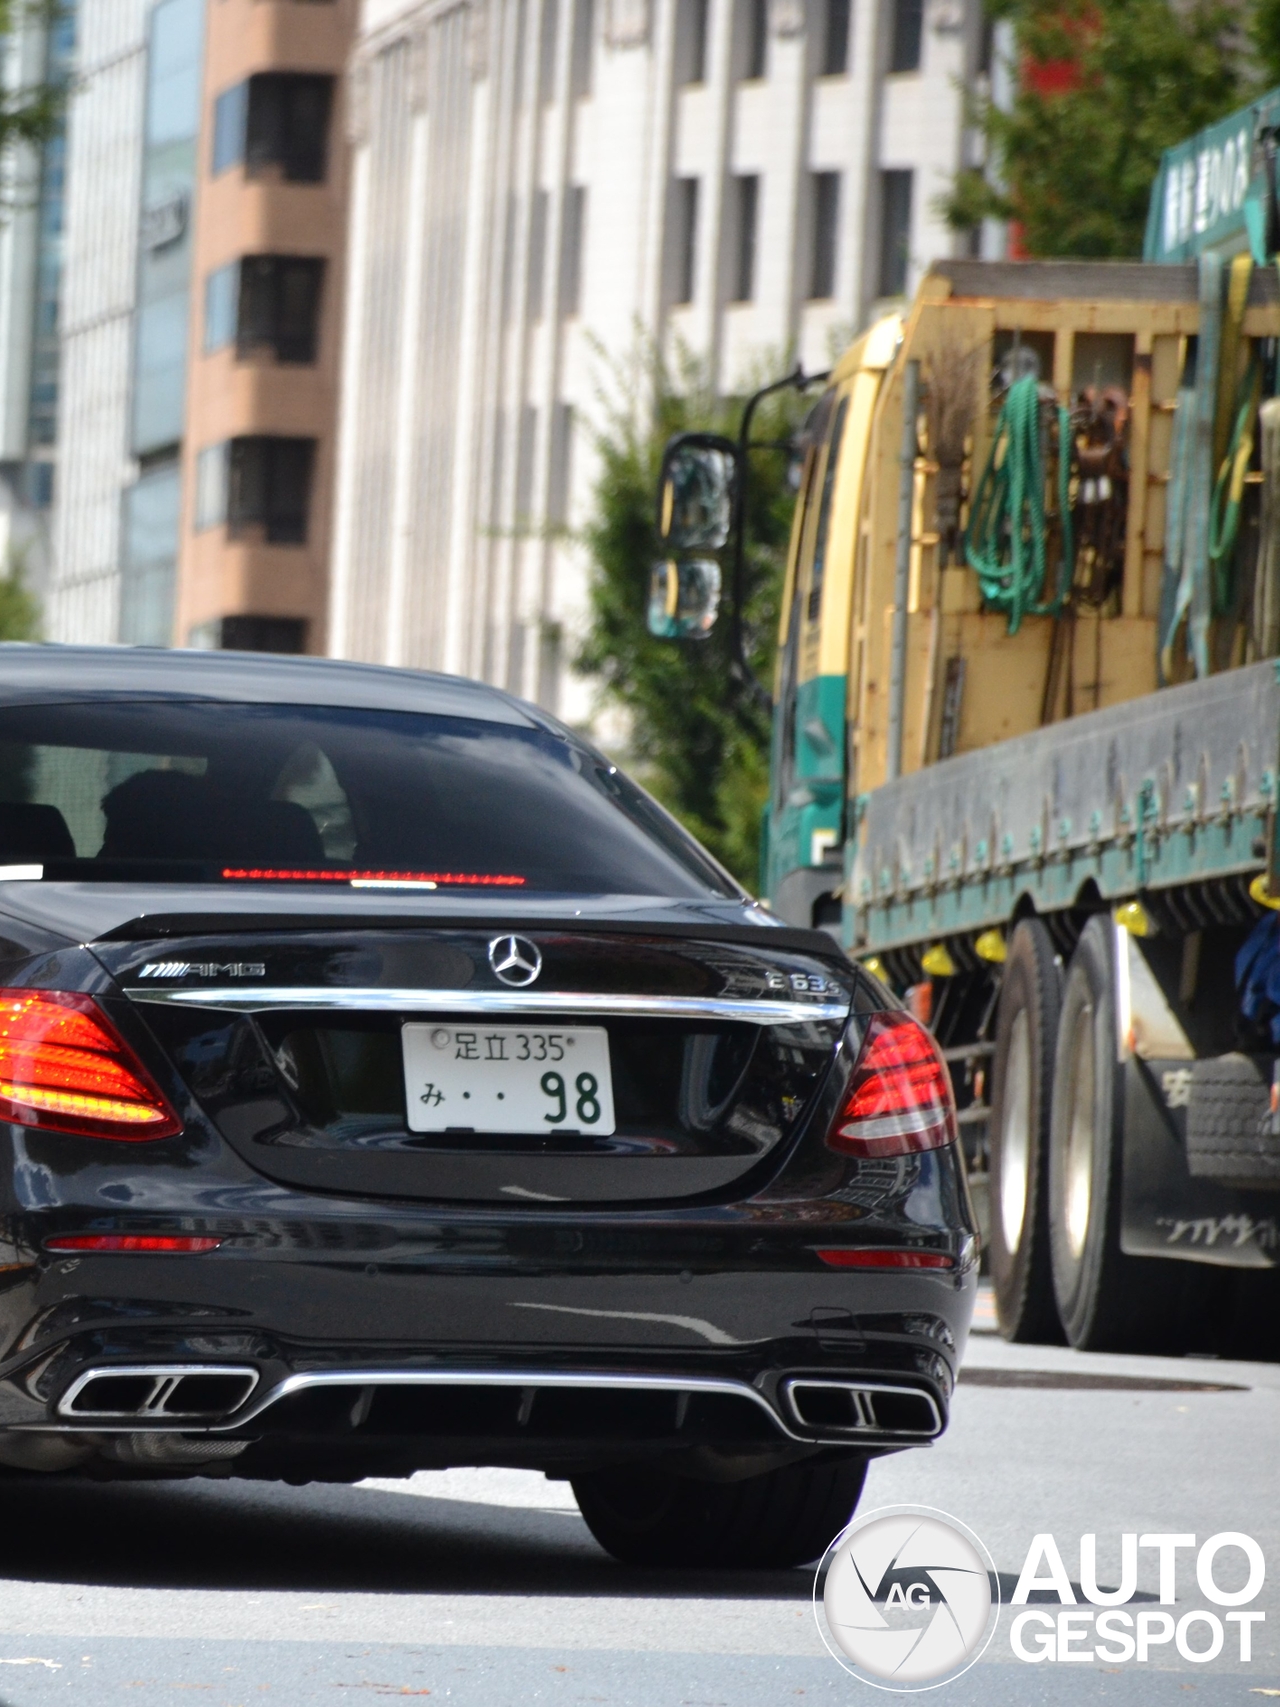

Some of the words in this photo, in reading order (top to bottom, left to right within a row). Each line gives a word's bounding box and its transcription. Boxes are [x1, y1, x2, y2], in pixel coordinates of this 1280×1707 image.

[182, 963, 266, 977] AMG
[765, 971, 785, 989] E
[455, 1033, 510, 1060] 足立
[516, 1034, 565, 1061] 335
[420, 1083, 446, 1107] み
[540, 1071, 601, 1124] 98
